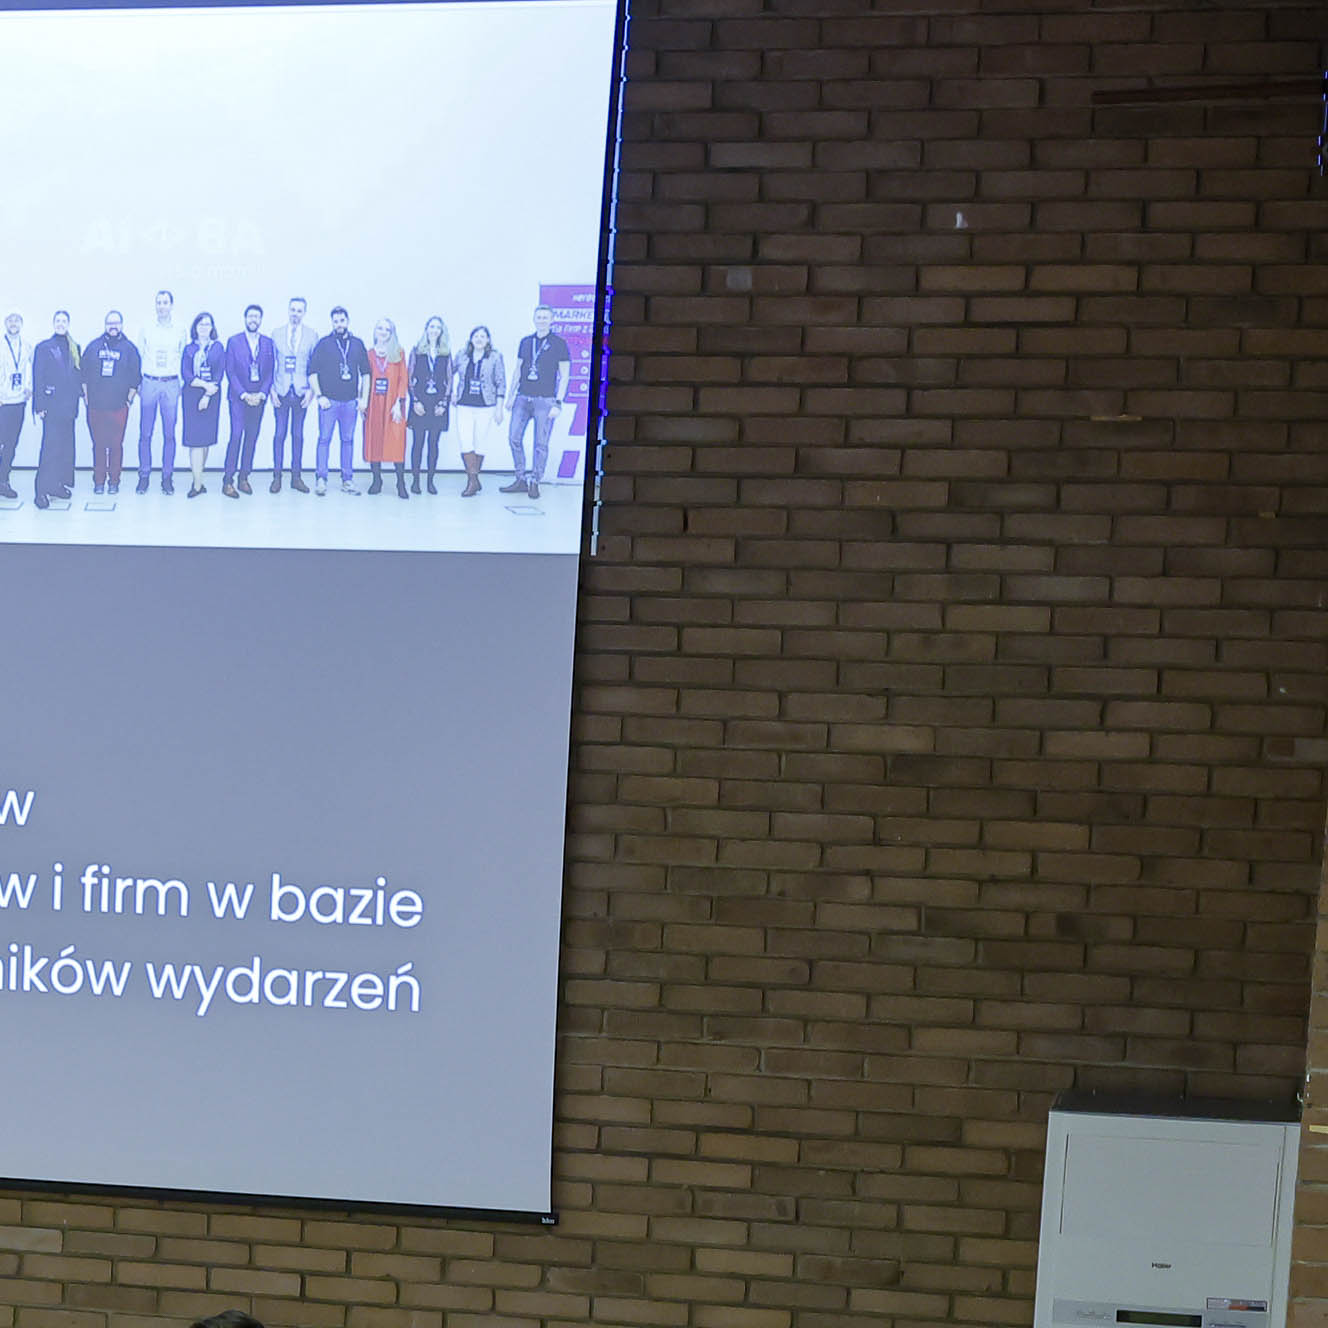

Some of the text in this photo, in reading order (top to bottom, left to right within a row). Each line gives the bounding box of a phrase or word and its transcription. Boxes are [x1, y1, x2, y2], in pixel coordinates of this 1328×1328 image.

[53, 862, 63, 910] i
[80, 864, 190, 917] firm
[207, 882, 255, 919] w
[270, 873, 424, 927] bazie
[146, 956, 421, 1017] wydarzeń
